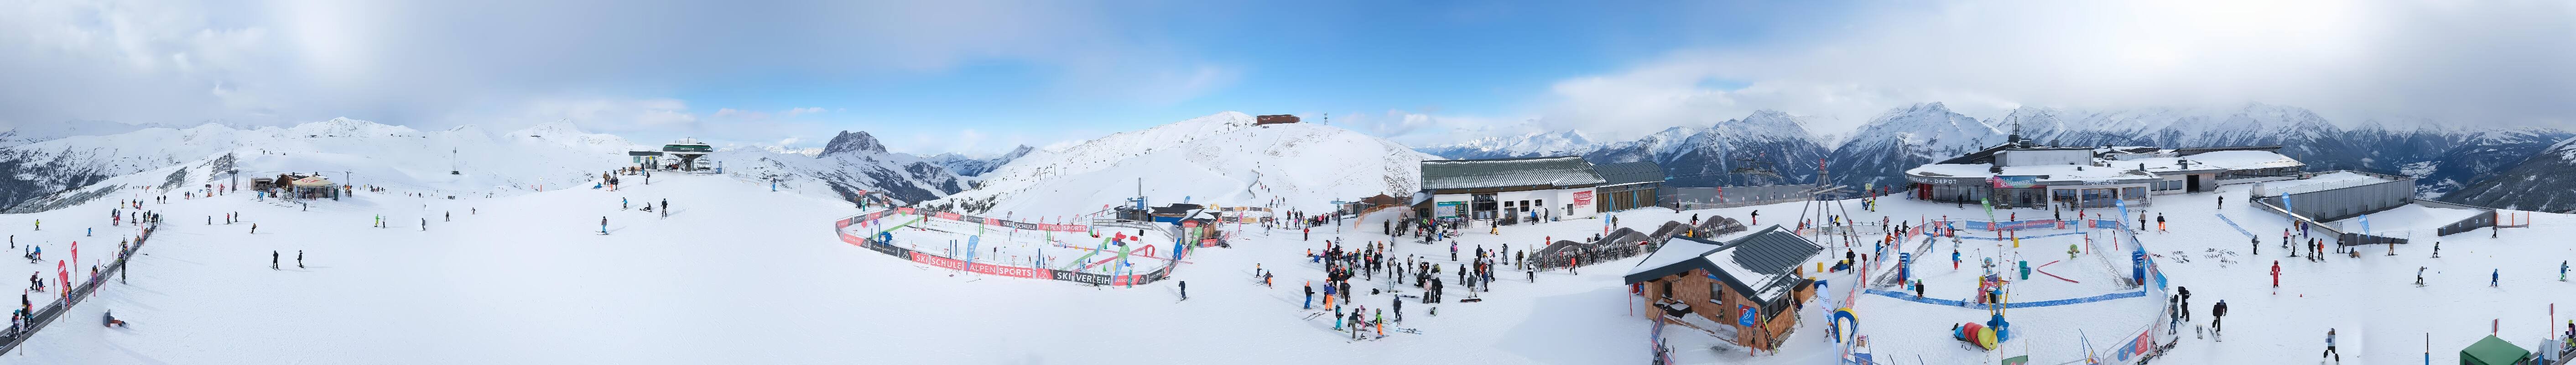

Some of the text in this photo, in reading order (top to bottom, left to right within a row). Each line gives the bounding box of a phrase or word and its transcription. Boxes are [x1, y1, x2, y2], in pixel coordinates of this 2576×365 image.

[916, 255, 1032, 276] SKI SCHULE ALPEN SPORTS
[1057, 272, 1111, 284] SKI VEREIH
